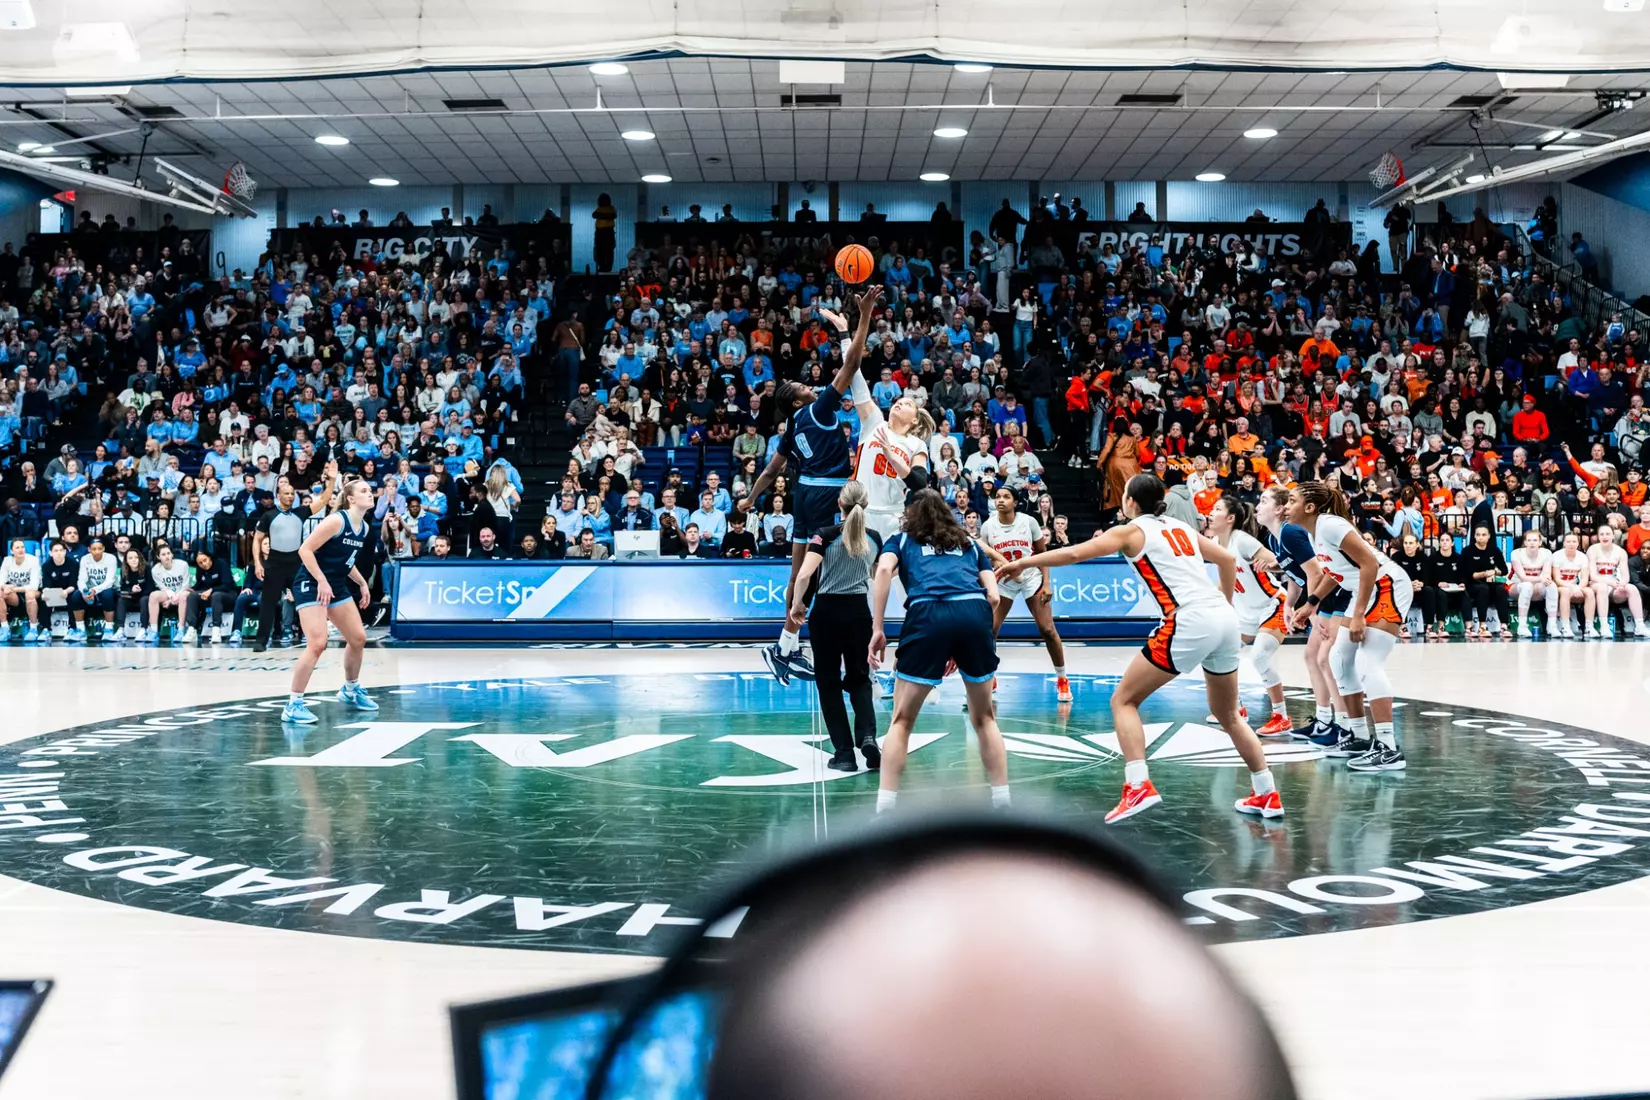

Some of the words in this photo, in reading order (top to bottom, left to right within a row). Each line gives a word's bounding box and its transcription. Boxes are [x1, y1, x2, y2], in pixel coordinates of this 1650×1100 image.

[993, 539, 1029, 551] PRINCETON
[1161, 527, 1196, 557] 10
[728, 579, 789, 604] Tick
[426, 677, 610, 691] YALE
[1452, 718, 1650, 786] CORNELL
[62, 845, 751, 939] HARVARD
